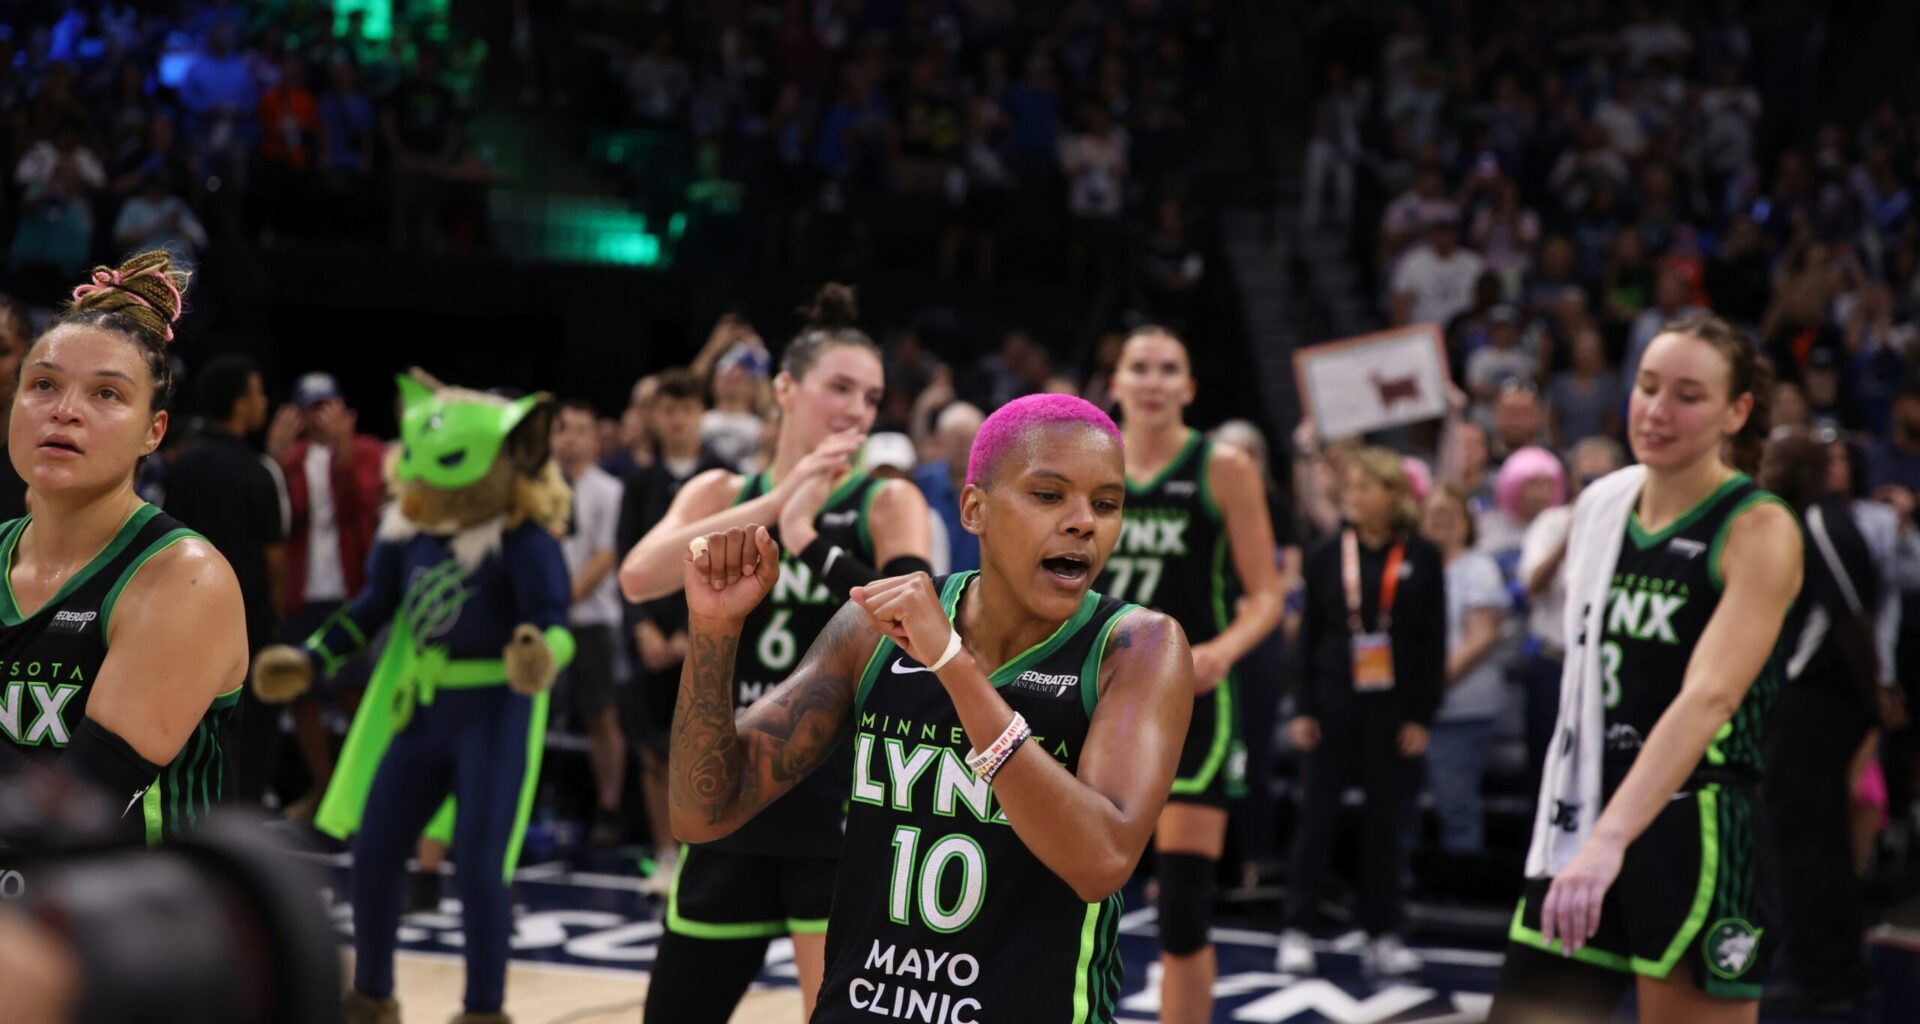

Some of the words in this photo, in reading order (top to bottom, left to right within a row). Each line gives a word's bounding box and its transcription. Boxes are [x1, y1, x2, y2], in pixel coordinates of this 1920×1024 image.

[1104, 556, 1163, 604] 77
[757, 607, 797, 671] 6
[0, 661, 84, 681] SOTA
[889, 825, 987, 934] 10
[864, 938, 980, 987] MAYO
[849, 977, 982, 1024] CLINIC
